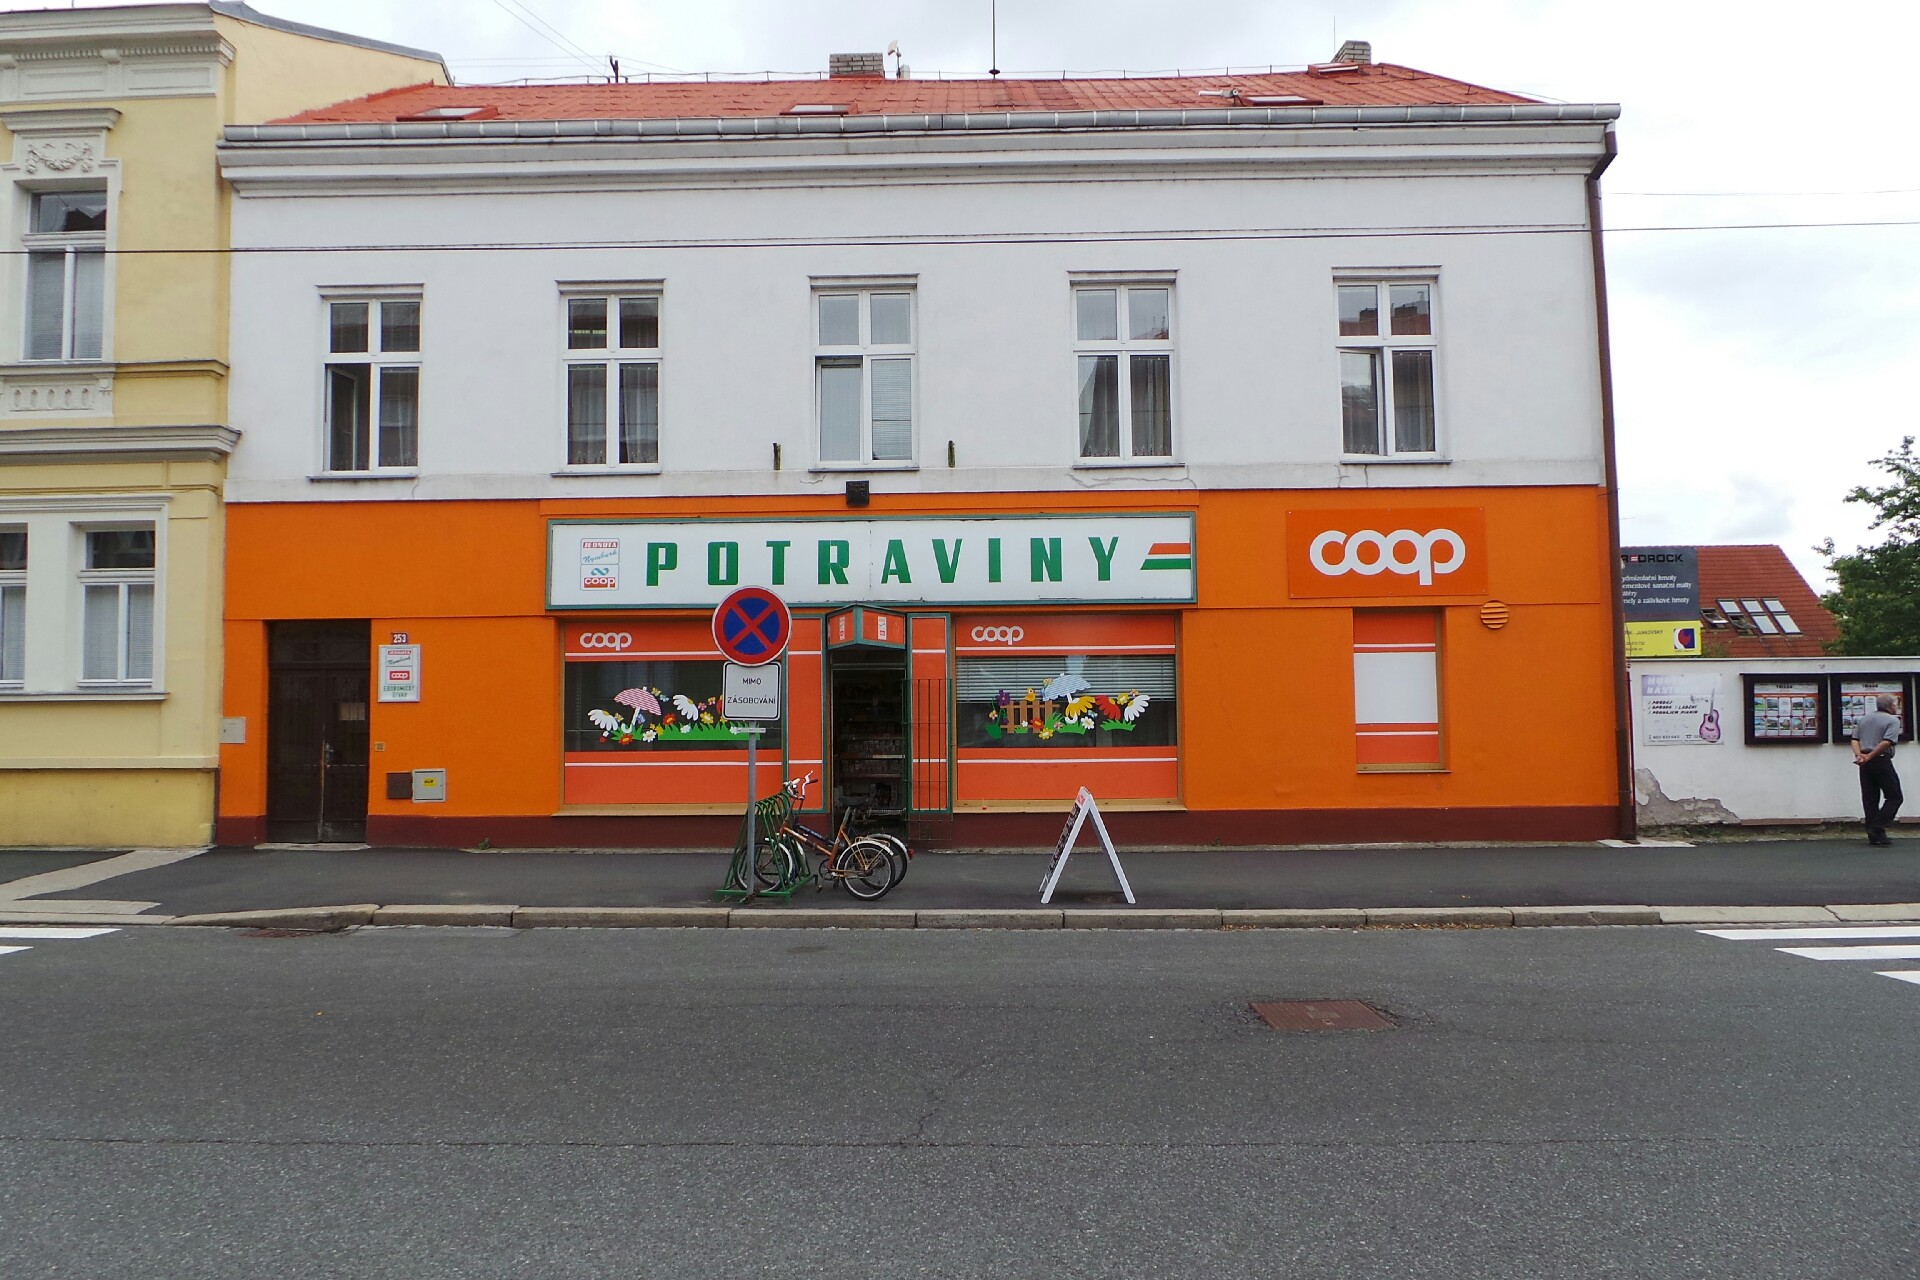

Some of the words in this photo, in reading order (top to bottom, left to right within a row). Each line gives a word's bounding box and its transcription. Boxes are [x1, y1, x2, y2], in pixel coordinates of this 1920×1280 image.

[646, 536, 1120, 587] POTRAVINY
[1309, 528, 1466, 586] coop
[584, 578, 616, 589] coop
[1621, 575, 1657, 583] ydroizolační
[393, 634, 407, 643] 253
[971, 624, 1024, 646] coop
[580, 632, 632, 651] coop
[391, 672, 409, 680] coop
[727, 694, 776, 704] ZÁSOBOVÁNÍ
